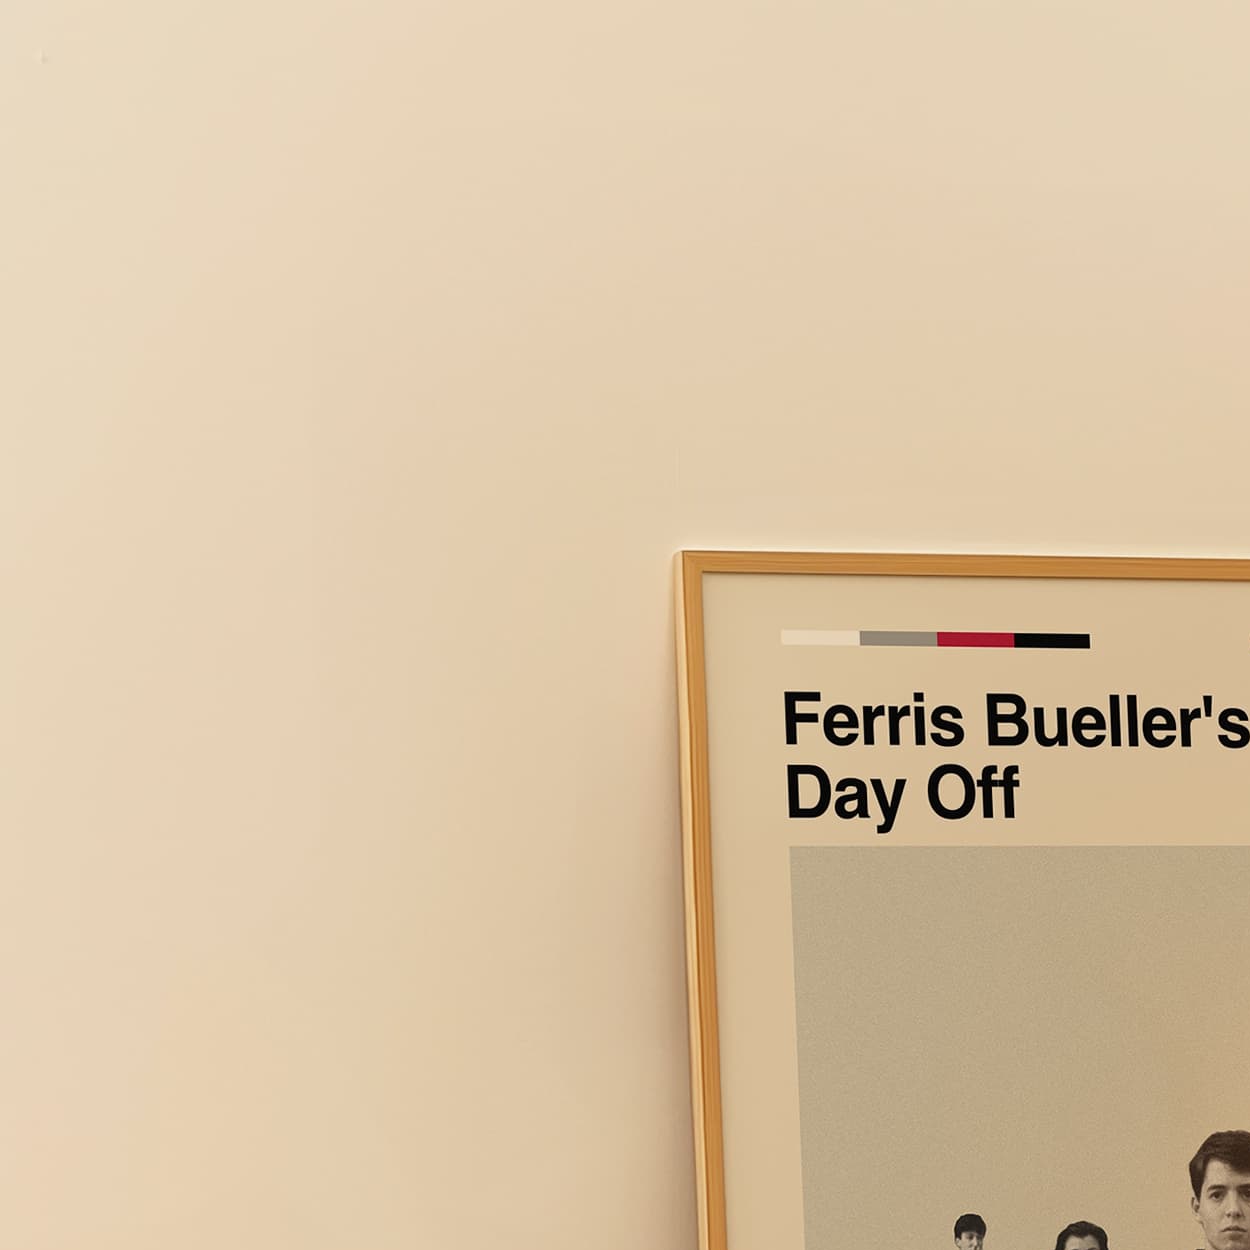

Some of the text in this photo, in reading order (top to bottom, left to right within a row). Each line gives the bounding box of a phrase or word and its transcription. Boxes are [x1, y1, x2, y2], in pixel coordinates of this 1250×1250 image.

[784, 692, 1250, 749] Ferris Bueller's
[787, 764, 1020, 834] Day Off
